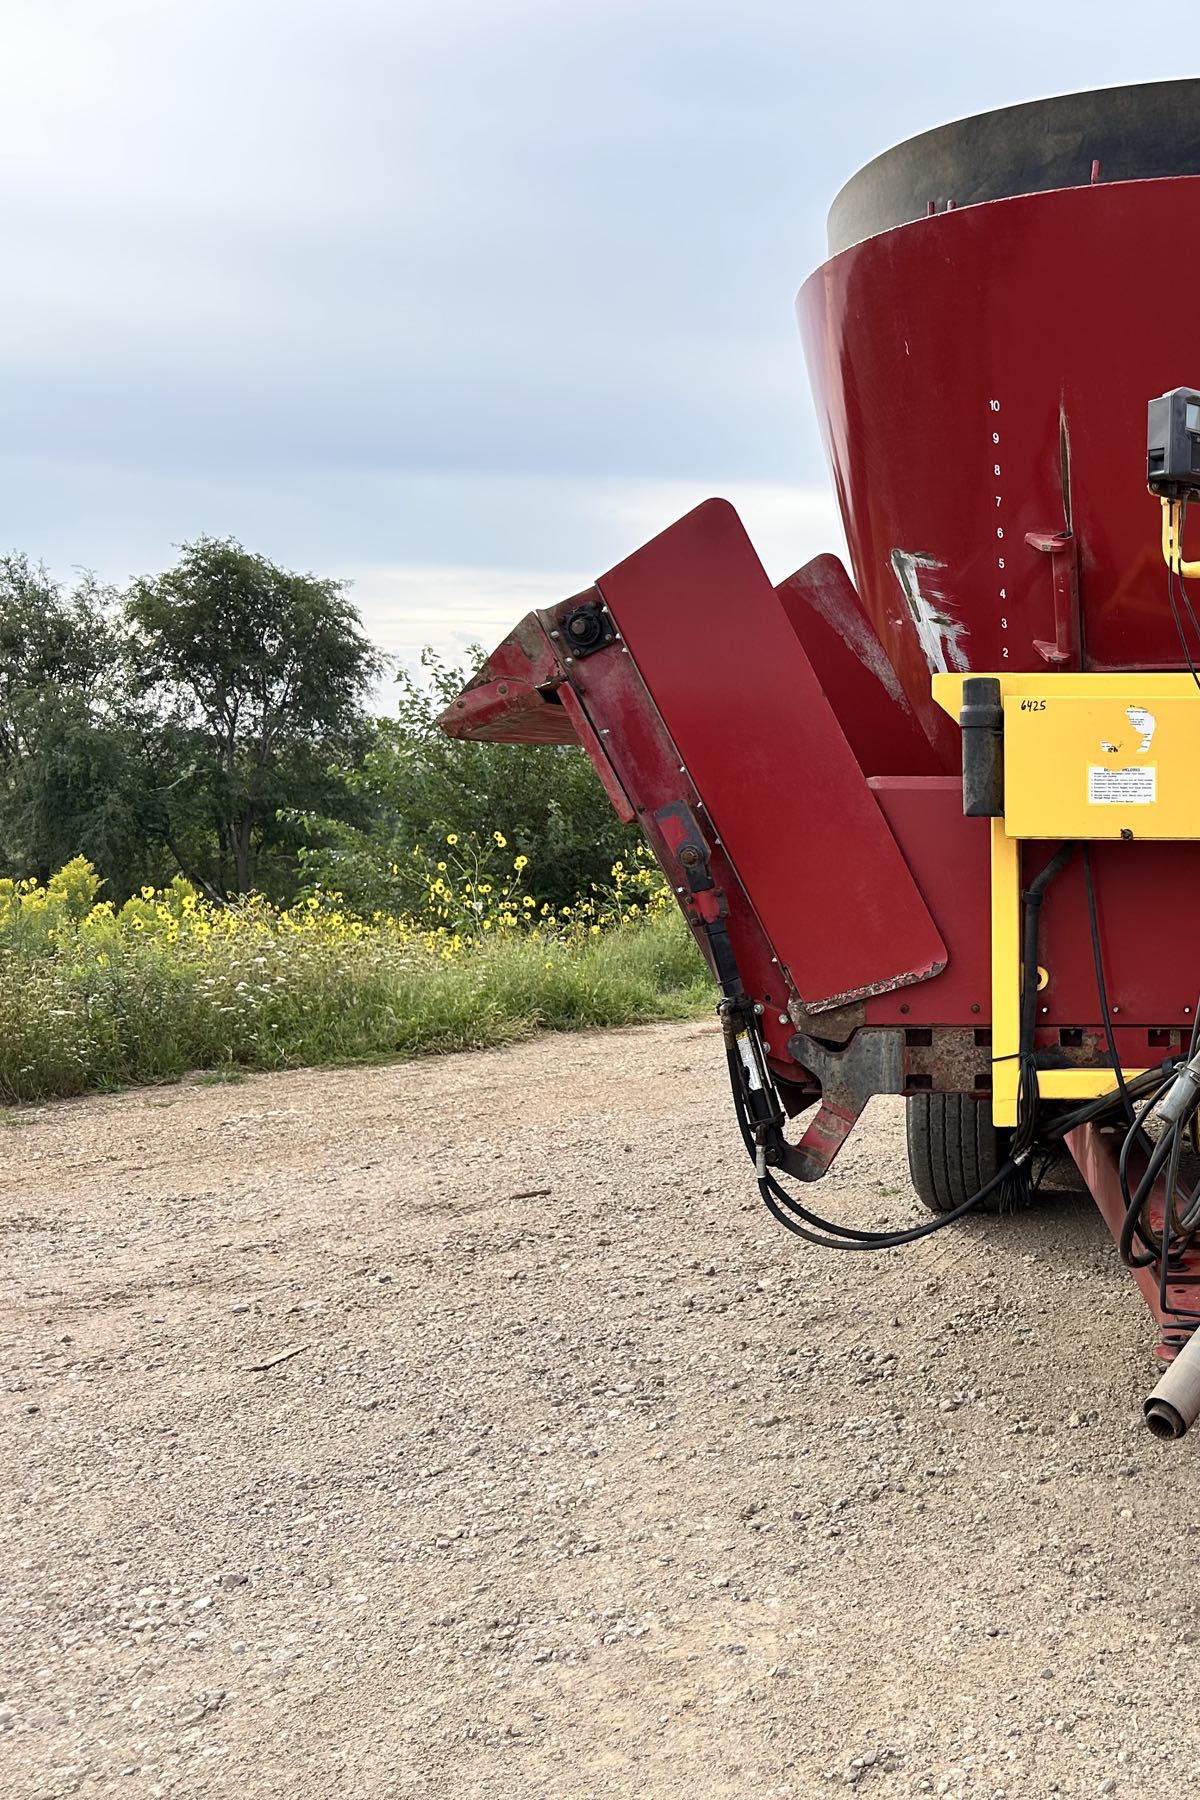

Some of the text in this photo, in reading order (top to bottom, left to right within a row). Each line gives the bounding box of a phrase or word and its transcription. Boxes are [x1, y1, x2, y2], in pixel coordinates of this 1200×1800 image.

[990, 400, 1000, 411] 10
[993, 433, 999, 444] 9
[995, 465, 1000, 476] 8
[996, 496, 1001, 507] 7
[997, 527, 1003, 538] 6
[999, 558, 1005, 569] 5
[1000, 588, 1006, 599] 4
[1002, 618, 1007, 628] 3
[1003, 647, 1008, 657] 2
[1021, 700, 1047, 711] 6425
